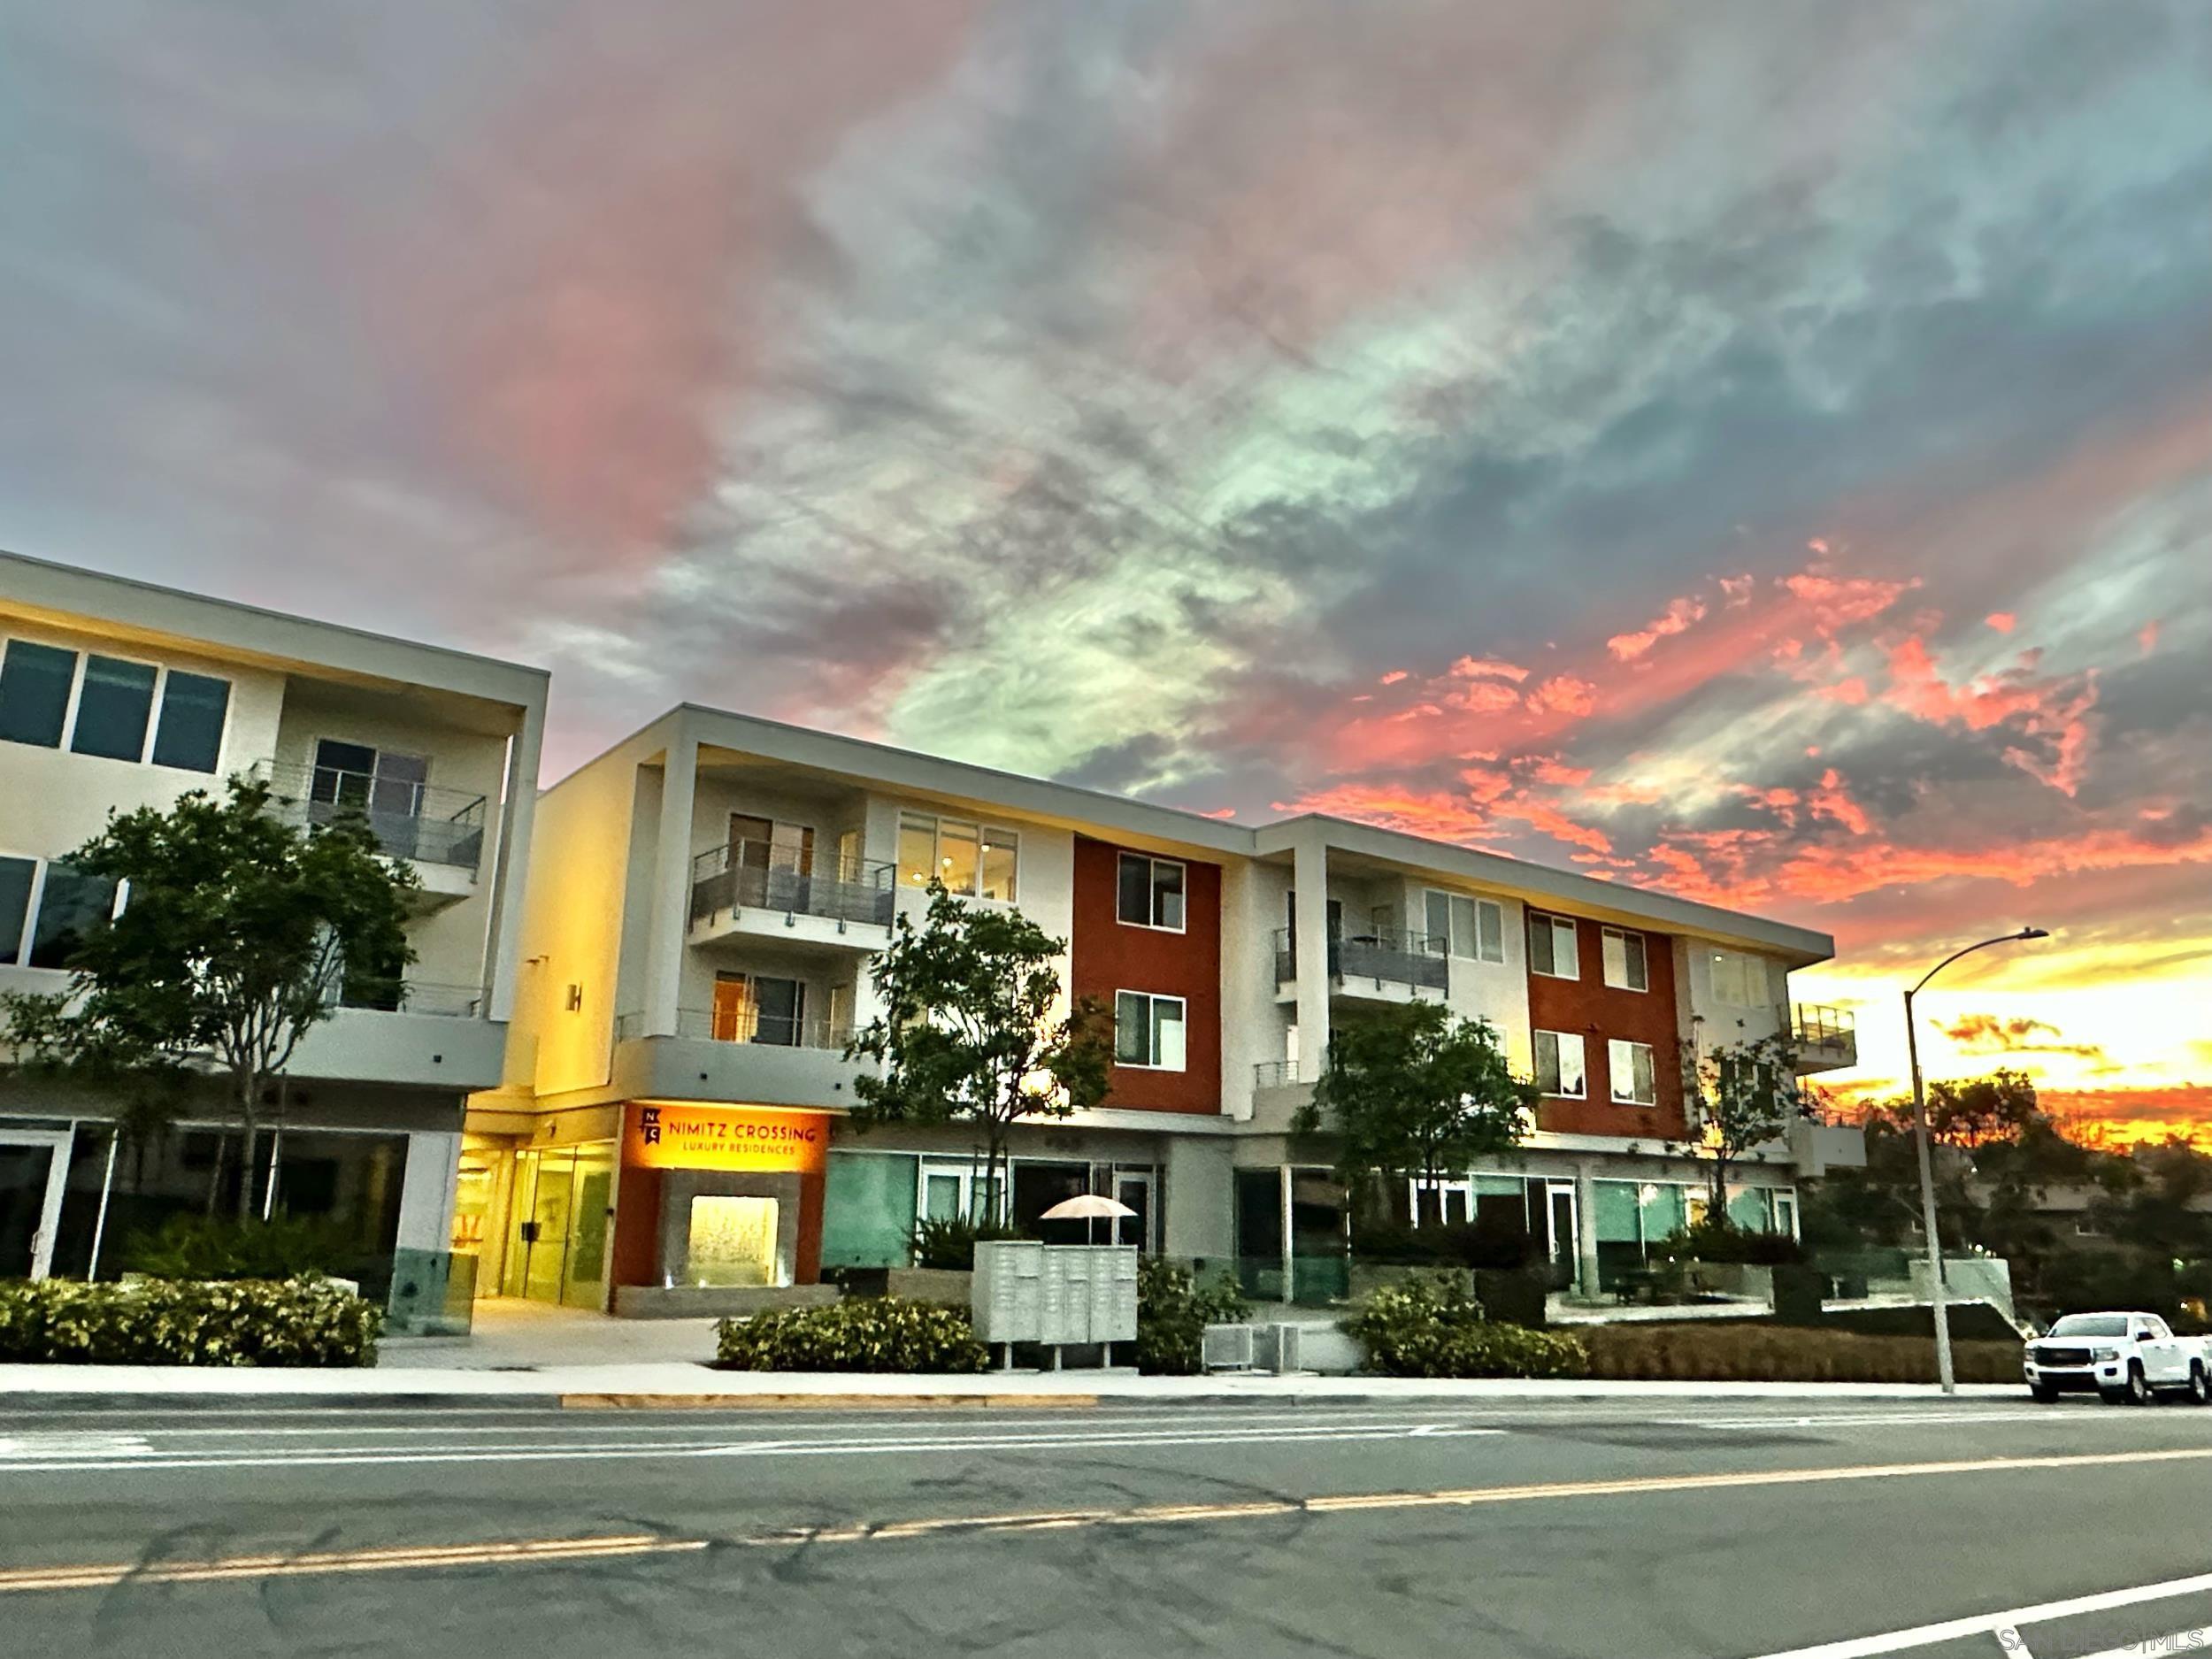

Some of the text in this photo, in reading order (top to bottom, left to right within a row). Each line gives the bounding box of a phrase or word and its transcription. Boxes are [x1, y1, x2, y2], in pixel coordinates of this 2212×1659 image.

[669, 1122, 816, 1142] NIMITZ CROSSING
[683, 1141, 795, 1155] LUXURY RESIDENCES
